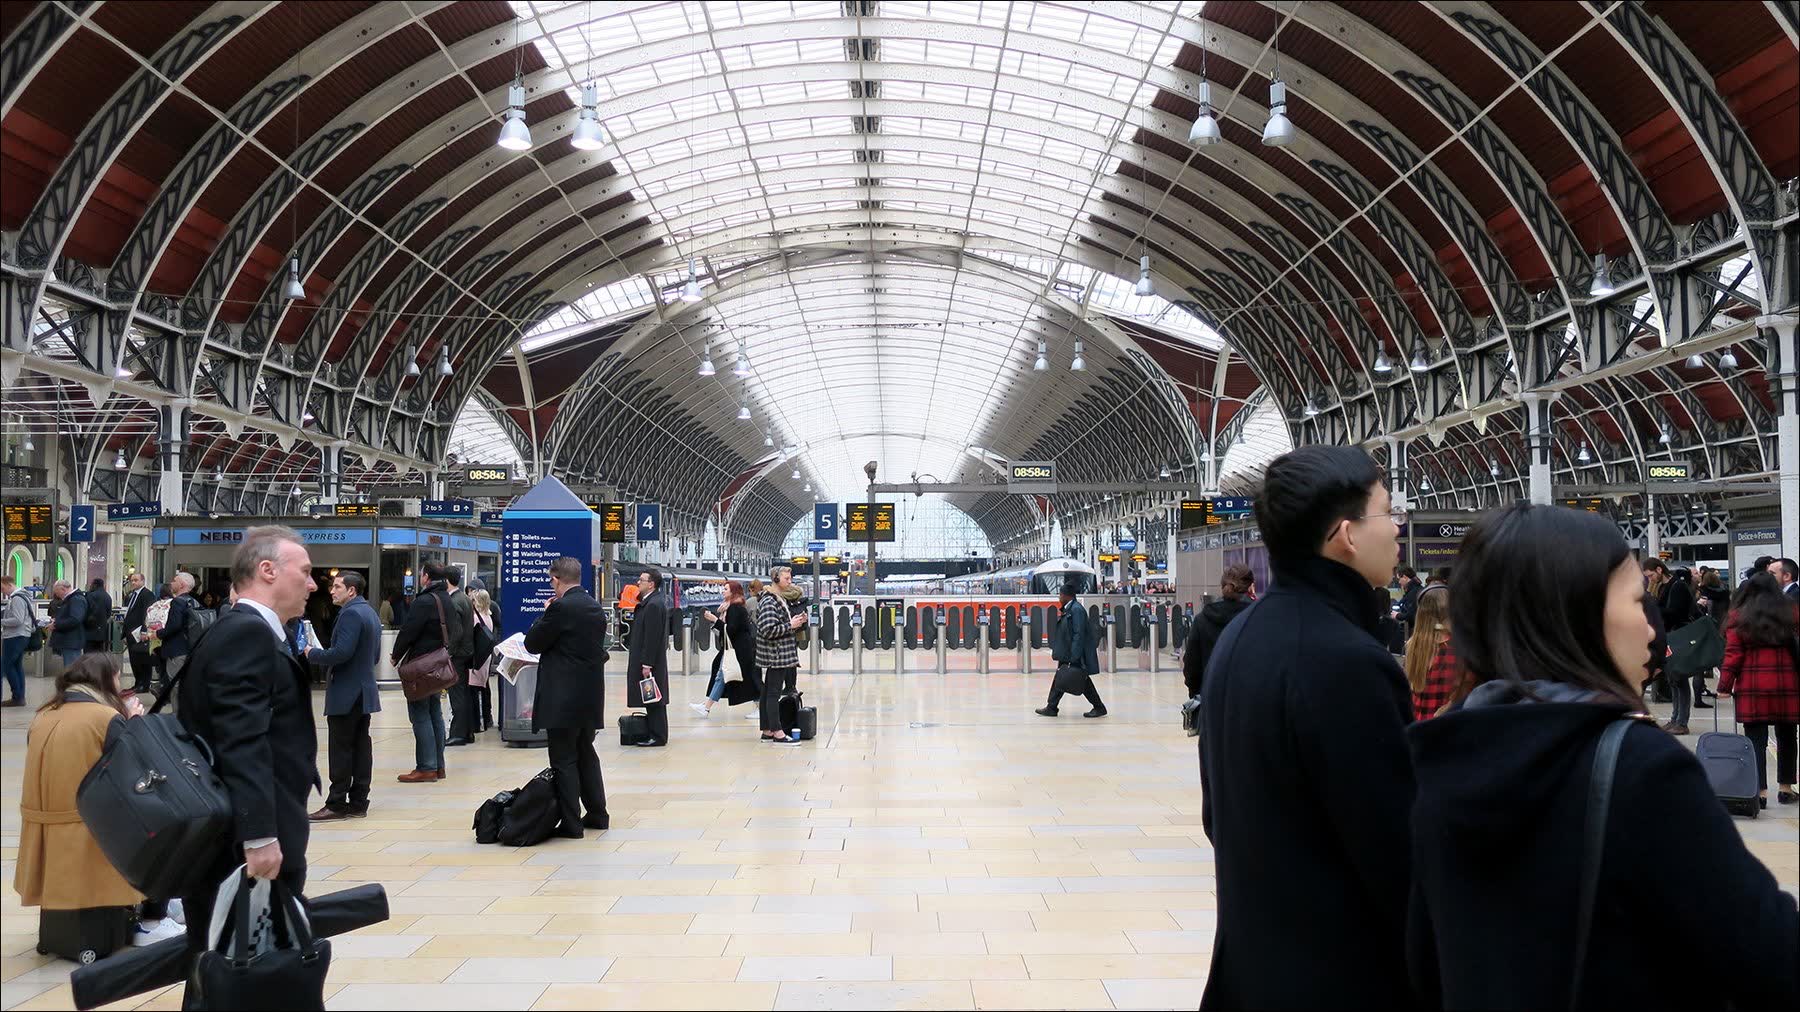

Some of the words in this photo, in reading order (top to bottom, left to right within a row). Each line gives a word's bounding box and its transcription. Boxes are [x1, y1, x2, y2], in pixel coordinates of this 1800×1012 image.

[77, 516, 87, 531] 2
[642, 515, 654, 530] 4
[820, 514, 832, 529] 5
